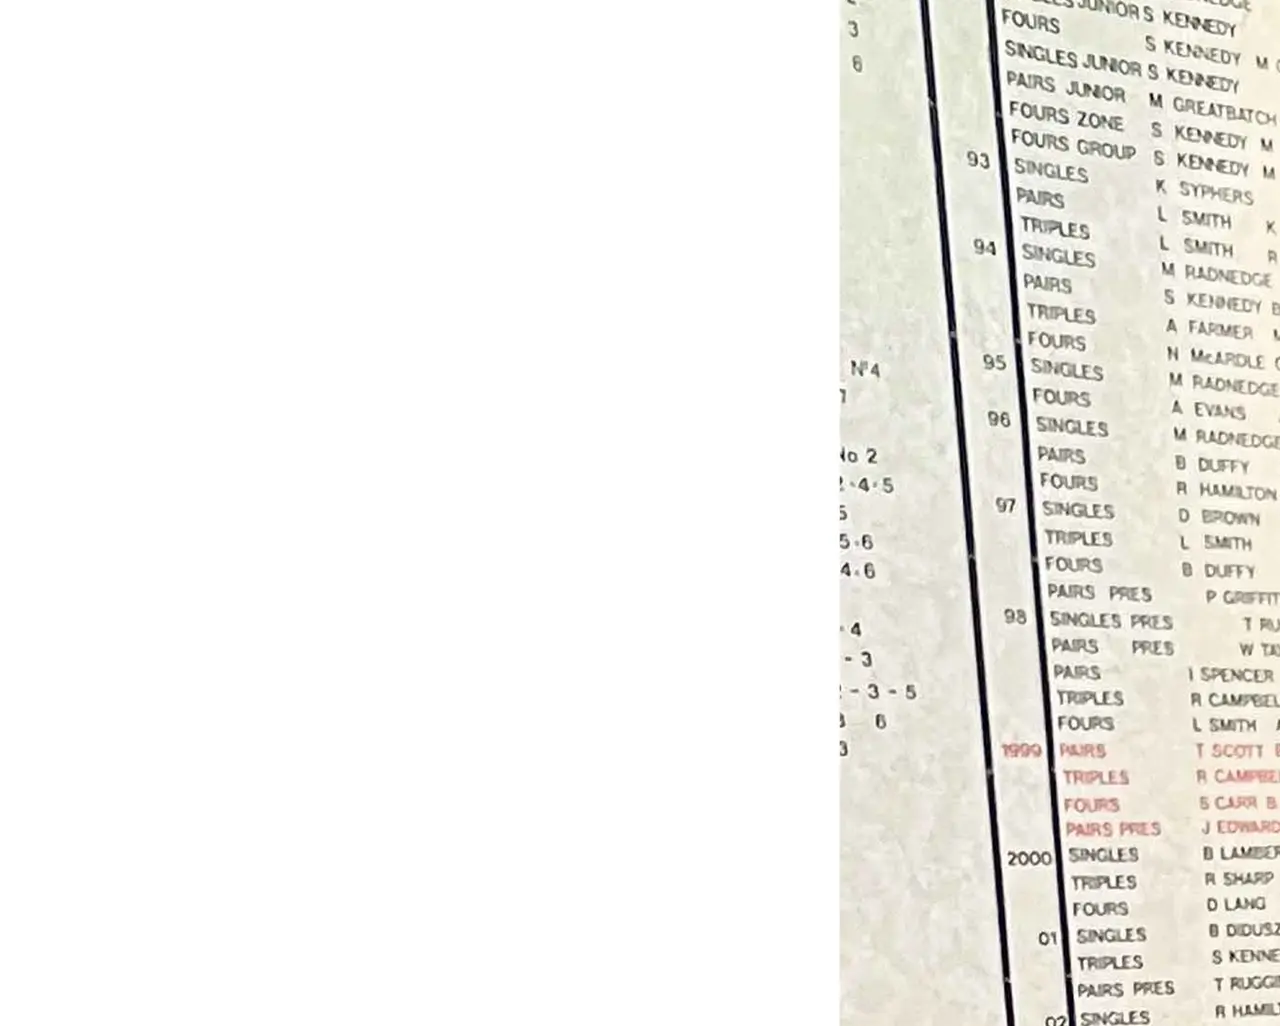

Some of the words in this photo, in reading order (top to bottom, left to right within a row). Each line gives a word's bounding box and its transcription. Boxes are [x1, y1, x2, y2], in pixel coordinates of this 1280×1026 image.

[1077, 0, 1140, 20] JUNIOR
[848, 20, 859, 37] 3
[1002, 9, 1060, 34] FOURS
[1163, 11, 1236, 37] KENNEDY
[1005, 40, 1077, 69] SINGLES
[1082, 51, 1141, 76] JUNIOR
[1146, 35, 1156, 51] S
[1164, 40, 1240, 65] KENNEDY
[1007, 71, 1055, 93] PAIRS
[1066, 81, 1125, 103] JUNIOR
[1148, 64, 1159, 80] S
[1167, 68, 1239, 94] KENNEDY
[1010, 101, 1069, 124] FOURS
[1078, 111, 1123, 132] ZONE
[1149, 93, 1163, 108] M
[1173, 97, 1276, 125] GREATBATCH
[1012, 129, 1069, 152] FOURS
[1077, 139, 1136, 160] GROUP
[967, 151, 990, 169] 93
[1015, 158, 1089, 183] SINGLES
[1017, 187, 1064, 209] PAIRS
[1156, 179, 1166, 193] K
[1180, 181, 1254, 206] SYPHERS
[1021, 216, 1090, 240] TRIPLES
[974, 239, 996, 255] 94
[1184, 238, 1233, 257] SMITH
[1022, 244, 1096, 268] SINGLES
[1162, 262, 1174, 275] M
[1185, 265, 1271, 288] RADNEDGE
[1024, 274, 1072, 294] PAIRS
[1028, 303, 1096, 325] TRIPLES
[1166, 319, 1177, 332] A
[1189, 320, 1253, 339] FARMER
[1028, 331, 1086, 352] FOURS
[983, 354, 1006, 370] 95
[1191, 348, 1264, 370] McARDLE
[1031, 358, 1103, 381] SINGLES
[1033, 388, 1091, 408] FOURS
[1172, 400, 1183, 414] A
[1195, 402, 1246, 420] EVANS
[988, 411, 1010, 427] 96
[1037, 416, 1109, 437] SINGLES
[866, 448, 877, 464] 2
[1038, 446, 1086, 464] PAIRS
[1199, 457, 1249, 473] DUFFY
[1040, 473, 1098, 492] FOURS
[1200, 483, 1277, 501] HAMILTON
[996, 497, 1015, 513] 97
[1043, 501, 1115, 519] SINGLES
[1202, 509, 1260, 526] BROWN
[1045, 529, 1113, 547] TRIPLES
[1045, 556, 1103, 573] FOURS
[1048, 584, 1095, 600] PAIRS
[1110, 586, 1152, 602] PRES
[1004, 609, 1026, 624] 98
[1050, 611, 1121, 629] SINGLES
[1131, 614, 1173, 630] PRES
[851, 622, 861, 636] 4
[1052, 638, 1099, 654] PAIRS
[1132, 640, 1174, 656] PRES
[1240, 643, 1253, 656] W
[861, 651, 872, 667] 3
[1054, 665, 1101, 680] PAIRS
[1201, 667, 1273, 683] SPENCER
[868, 684, 879, 699] 3
[906, 685, 917, 700] 5
[1057, 690, 1124, 706] TRIPLES
[1058, 716, 1115, 731] FOURS
[1193, 718, 1202, 732] L
[1210, 718, 1256, 732] SMITH
[1002, 743, 1041, 757] 1999
[1061, 744, 1106, 758] PAIRS
[1212, 744, 1263, 758] SCOTT
[1064, 770, 1129, 785] TRIPLES
[1065, 798, 1120, 813] FOURS
[1067, 822, 1112, 837] PAIRS
[1119, 821, 1161, 836] PRES
[1008, 851, 1052, 866] 2000
[1069, 847, 1139, 862] SINGLES
[1072, 875, 1137, 890] TRIPLES
[1224, 872, 1274, 886] SHARP
[1073, 901, 1128, 916] FOURS
[1224, 897, 1266, 911] LANG
[1039, 932, 1056, 946] 01
[1078, 927, 1147, 943] SINGLES
[1078, 955, 1143, 970] TRIPLES
[1078, 983, 1124, 998] PAIRS
[1133, 981, 1175, 995] PRES
[1081, 1011, 1150, 1026] SINGLES
